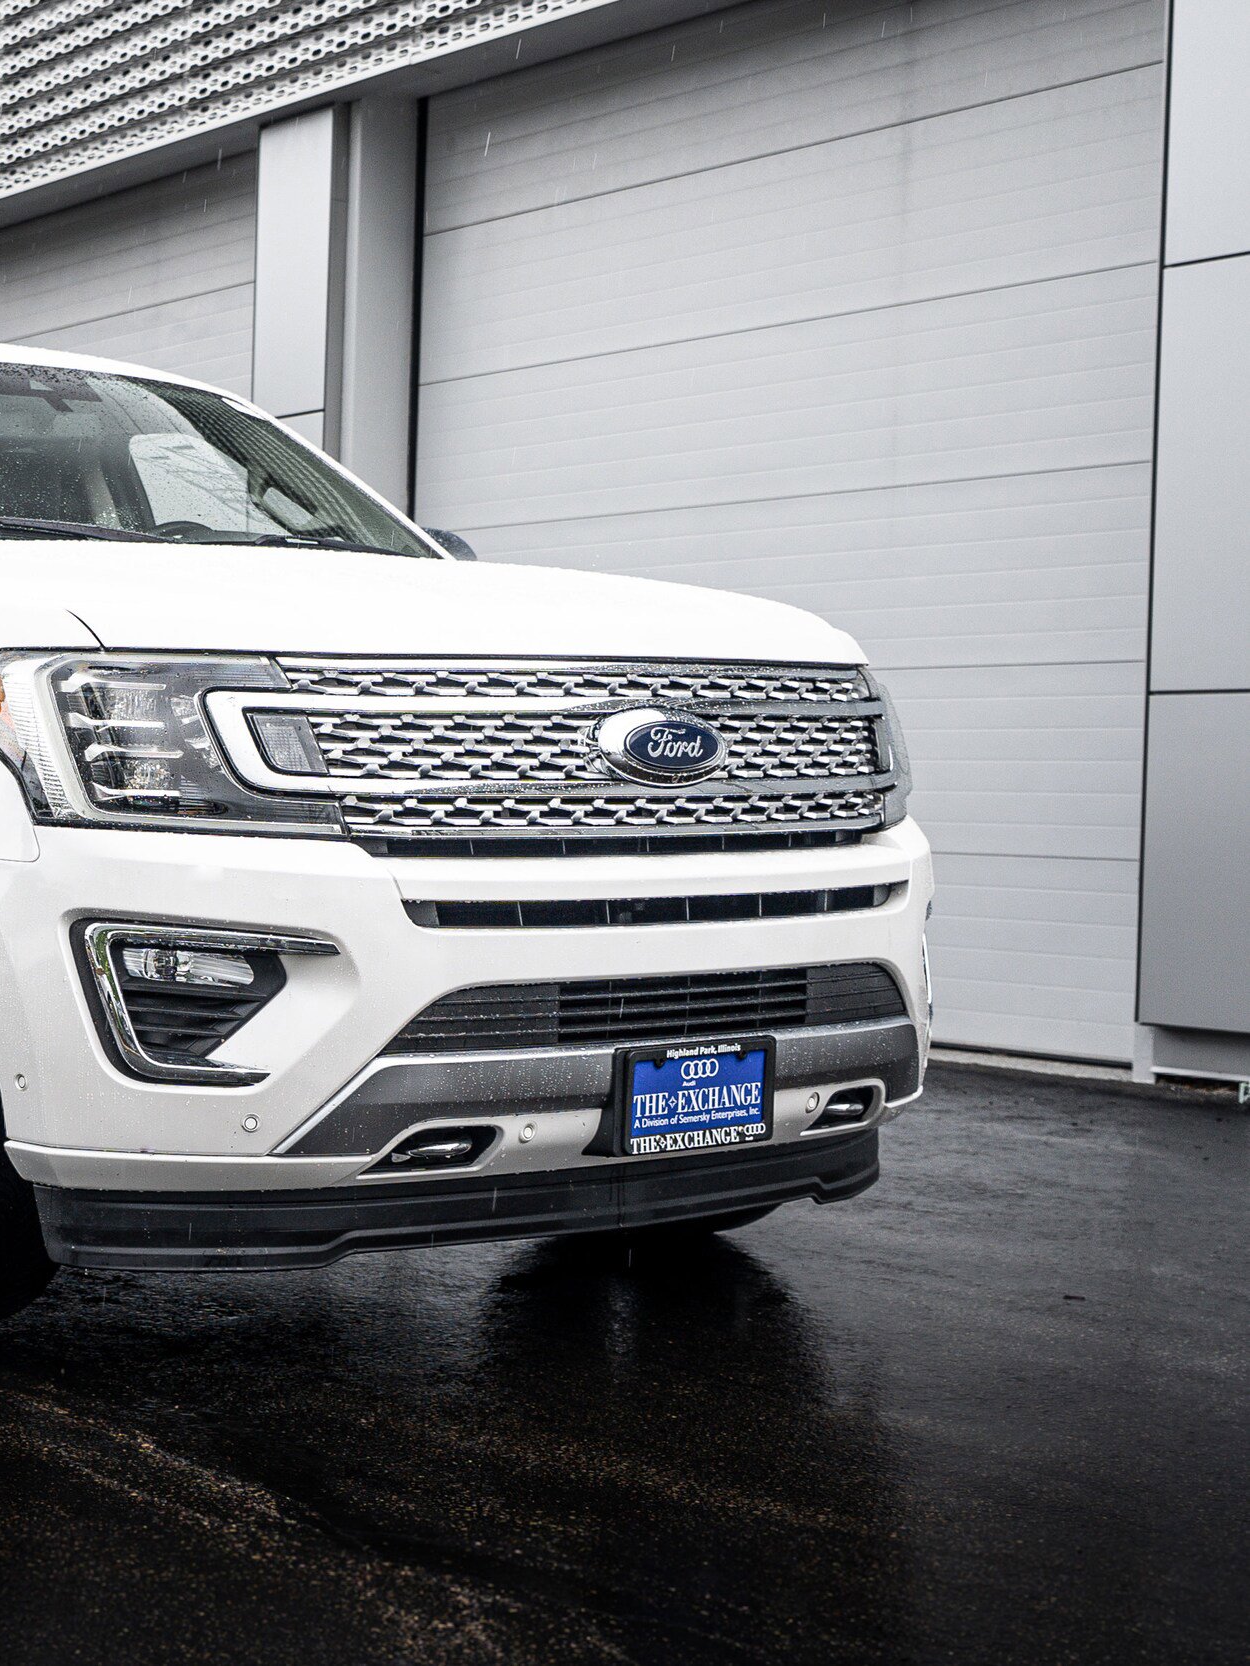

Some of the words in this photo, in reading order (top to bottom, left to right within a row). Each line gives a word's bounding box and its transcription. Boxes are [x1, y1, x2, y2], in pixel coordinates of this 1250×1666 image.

[647, 726, 704, 758] Ford
[666, 1047, 699, 1059] Highland
[699, 1045, 717, 1055] Park,
[717, 1043, 741, 1053] Illinois
[633, 1092, 669, 1118] THE
[676, 1082, 761, 1113] EXCHANGE
[633, 1120, 641, 1129] A
[641, 1116, 669, 1128] Division
[669, 1114, 678, 1125] of
[748, 1106, 761, 1116] Inc.
[630, 1136, 660, 1155] THE
